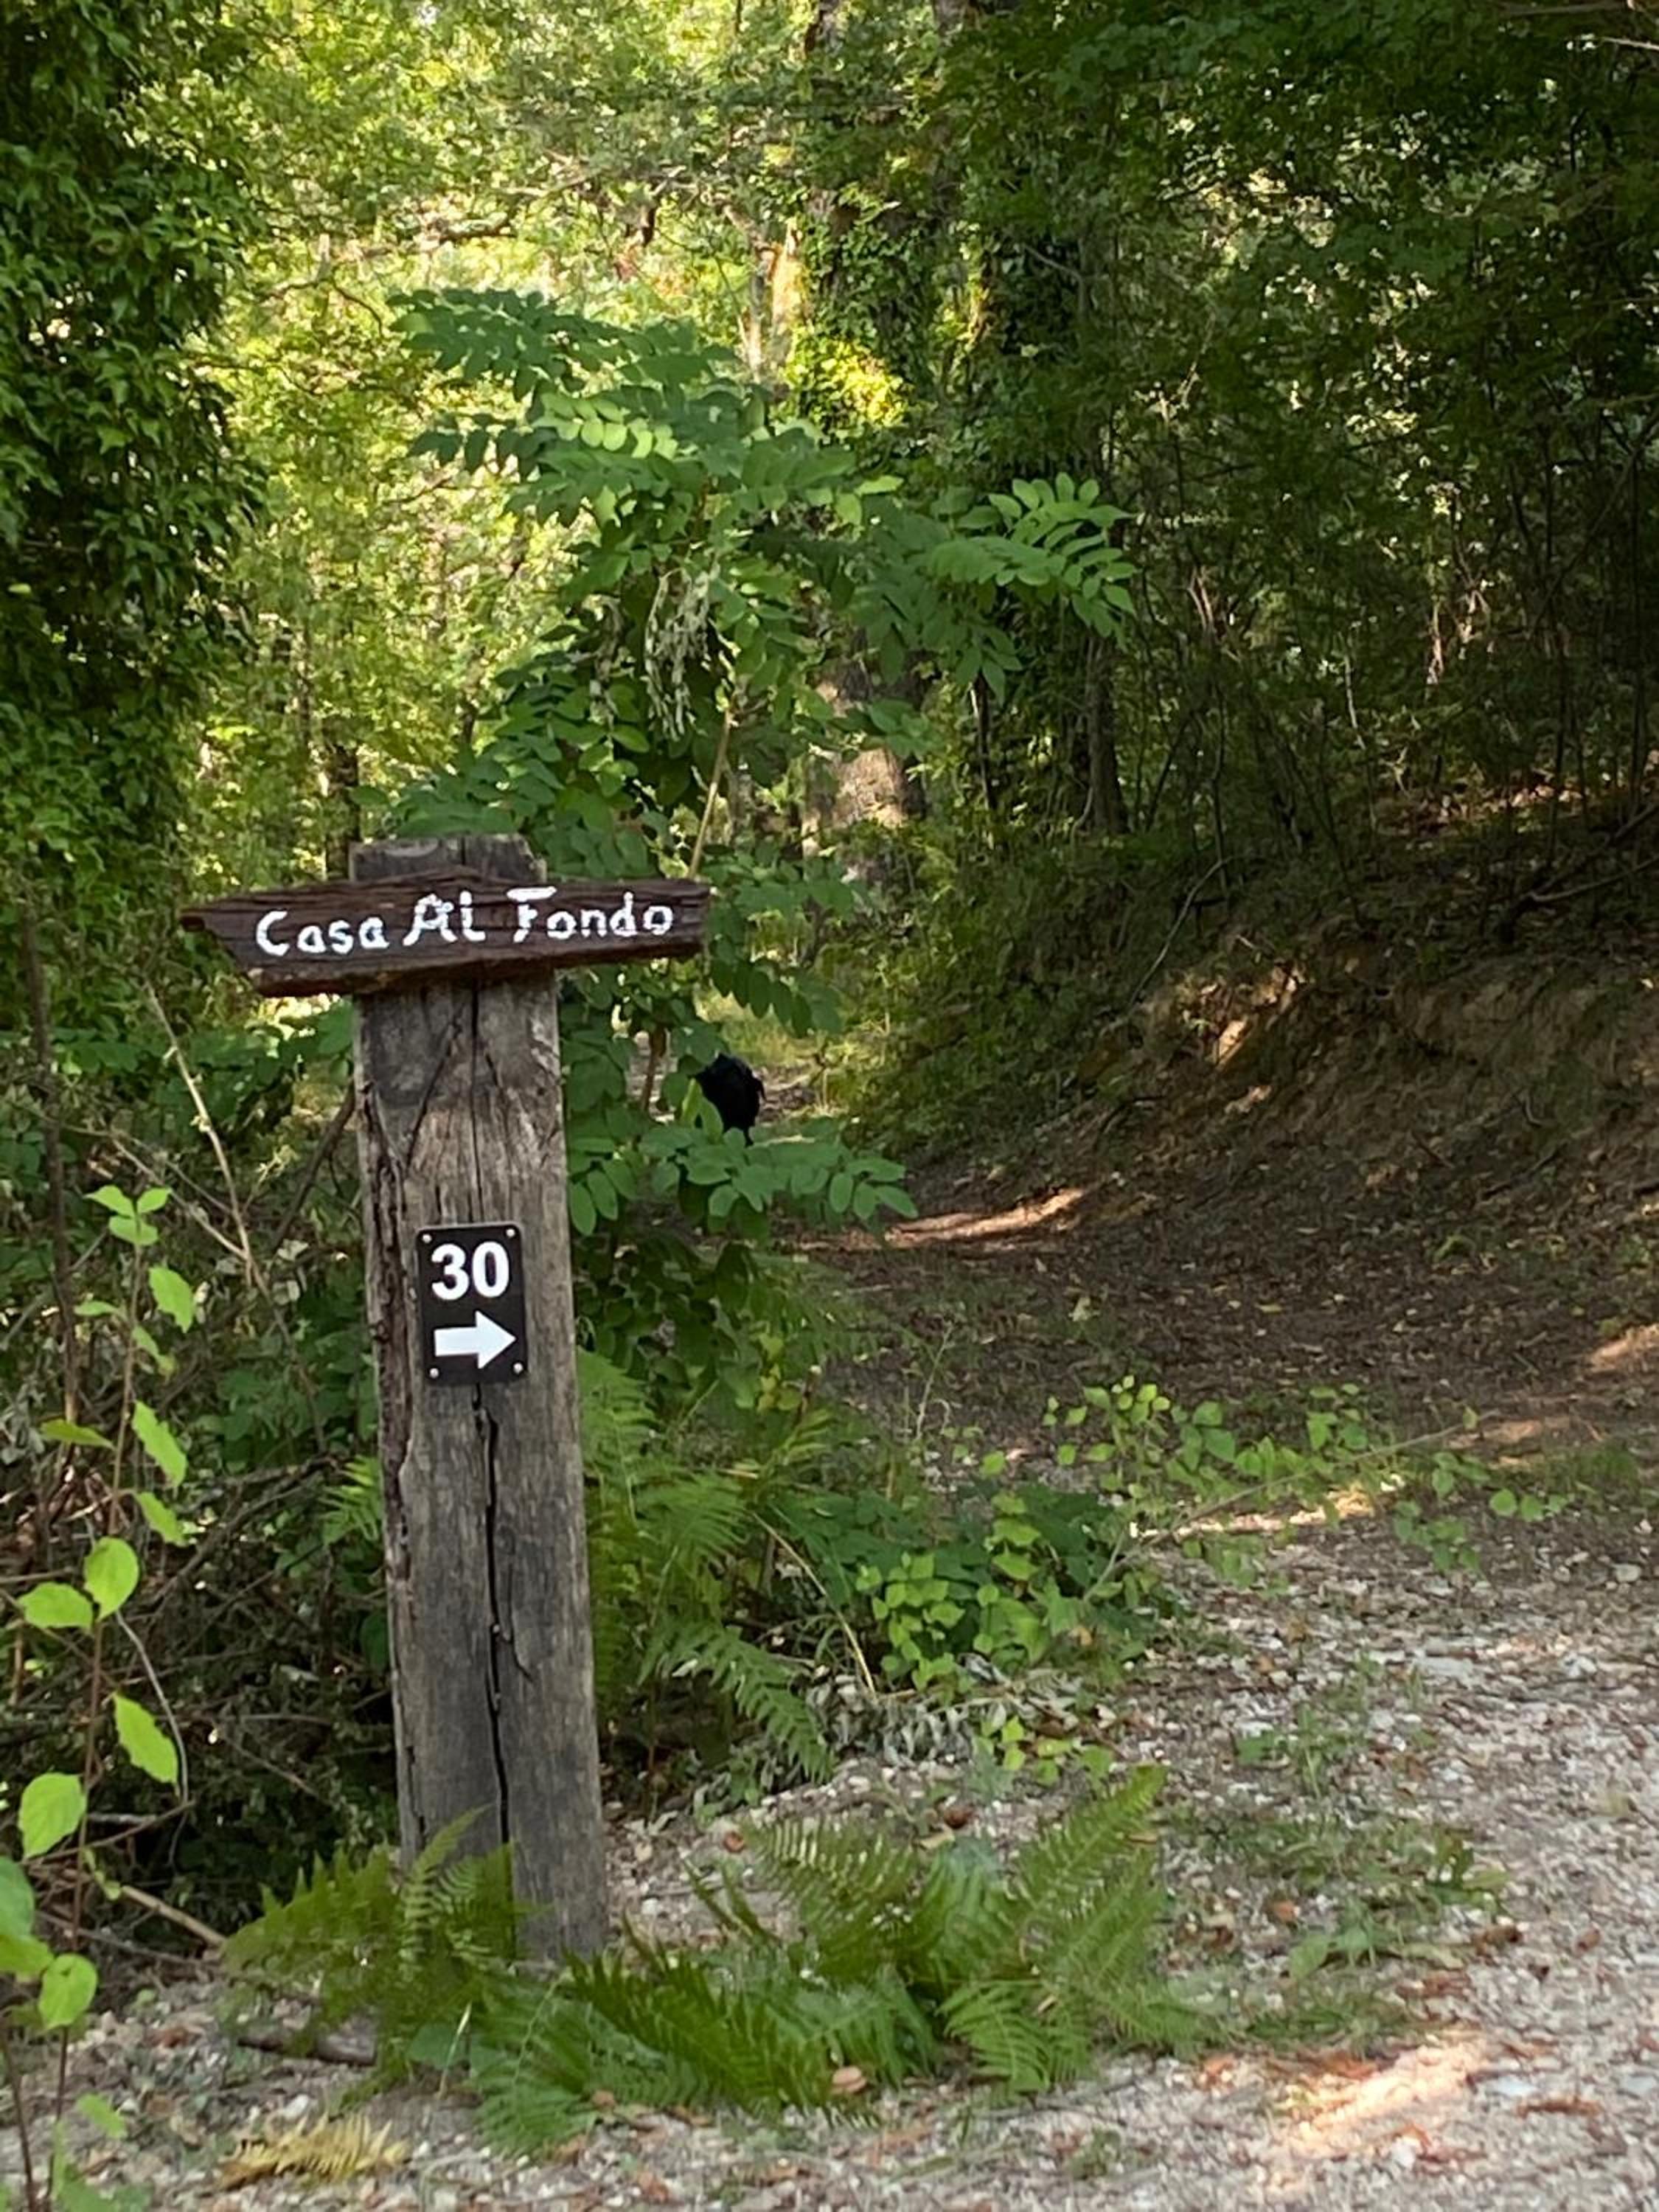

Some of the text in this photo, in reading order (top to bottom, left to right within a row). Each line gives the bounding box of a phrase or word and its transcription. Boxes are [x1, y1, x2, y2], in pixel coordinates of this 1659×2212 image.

[255, 909, 392, 957] Casa
[506, 884, 675, 944] Fondo
[431, 1241, 510, 1301] 30
